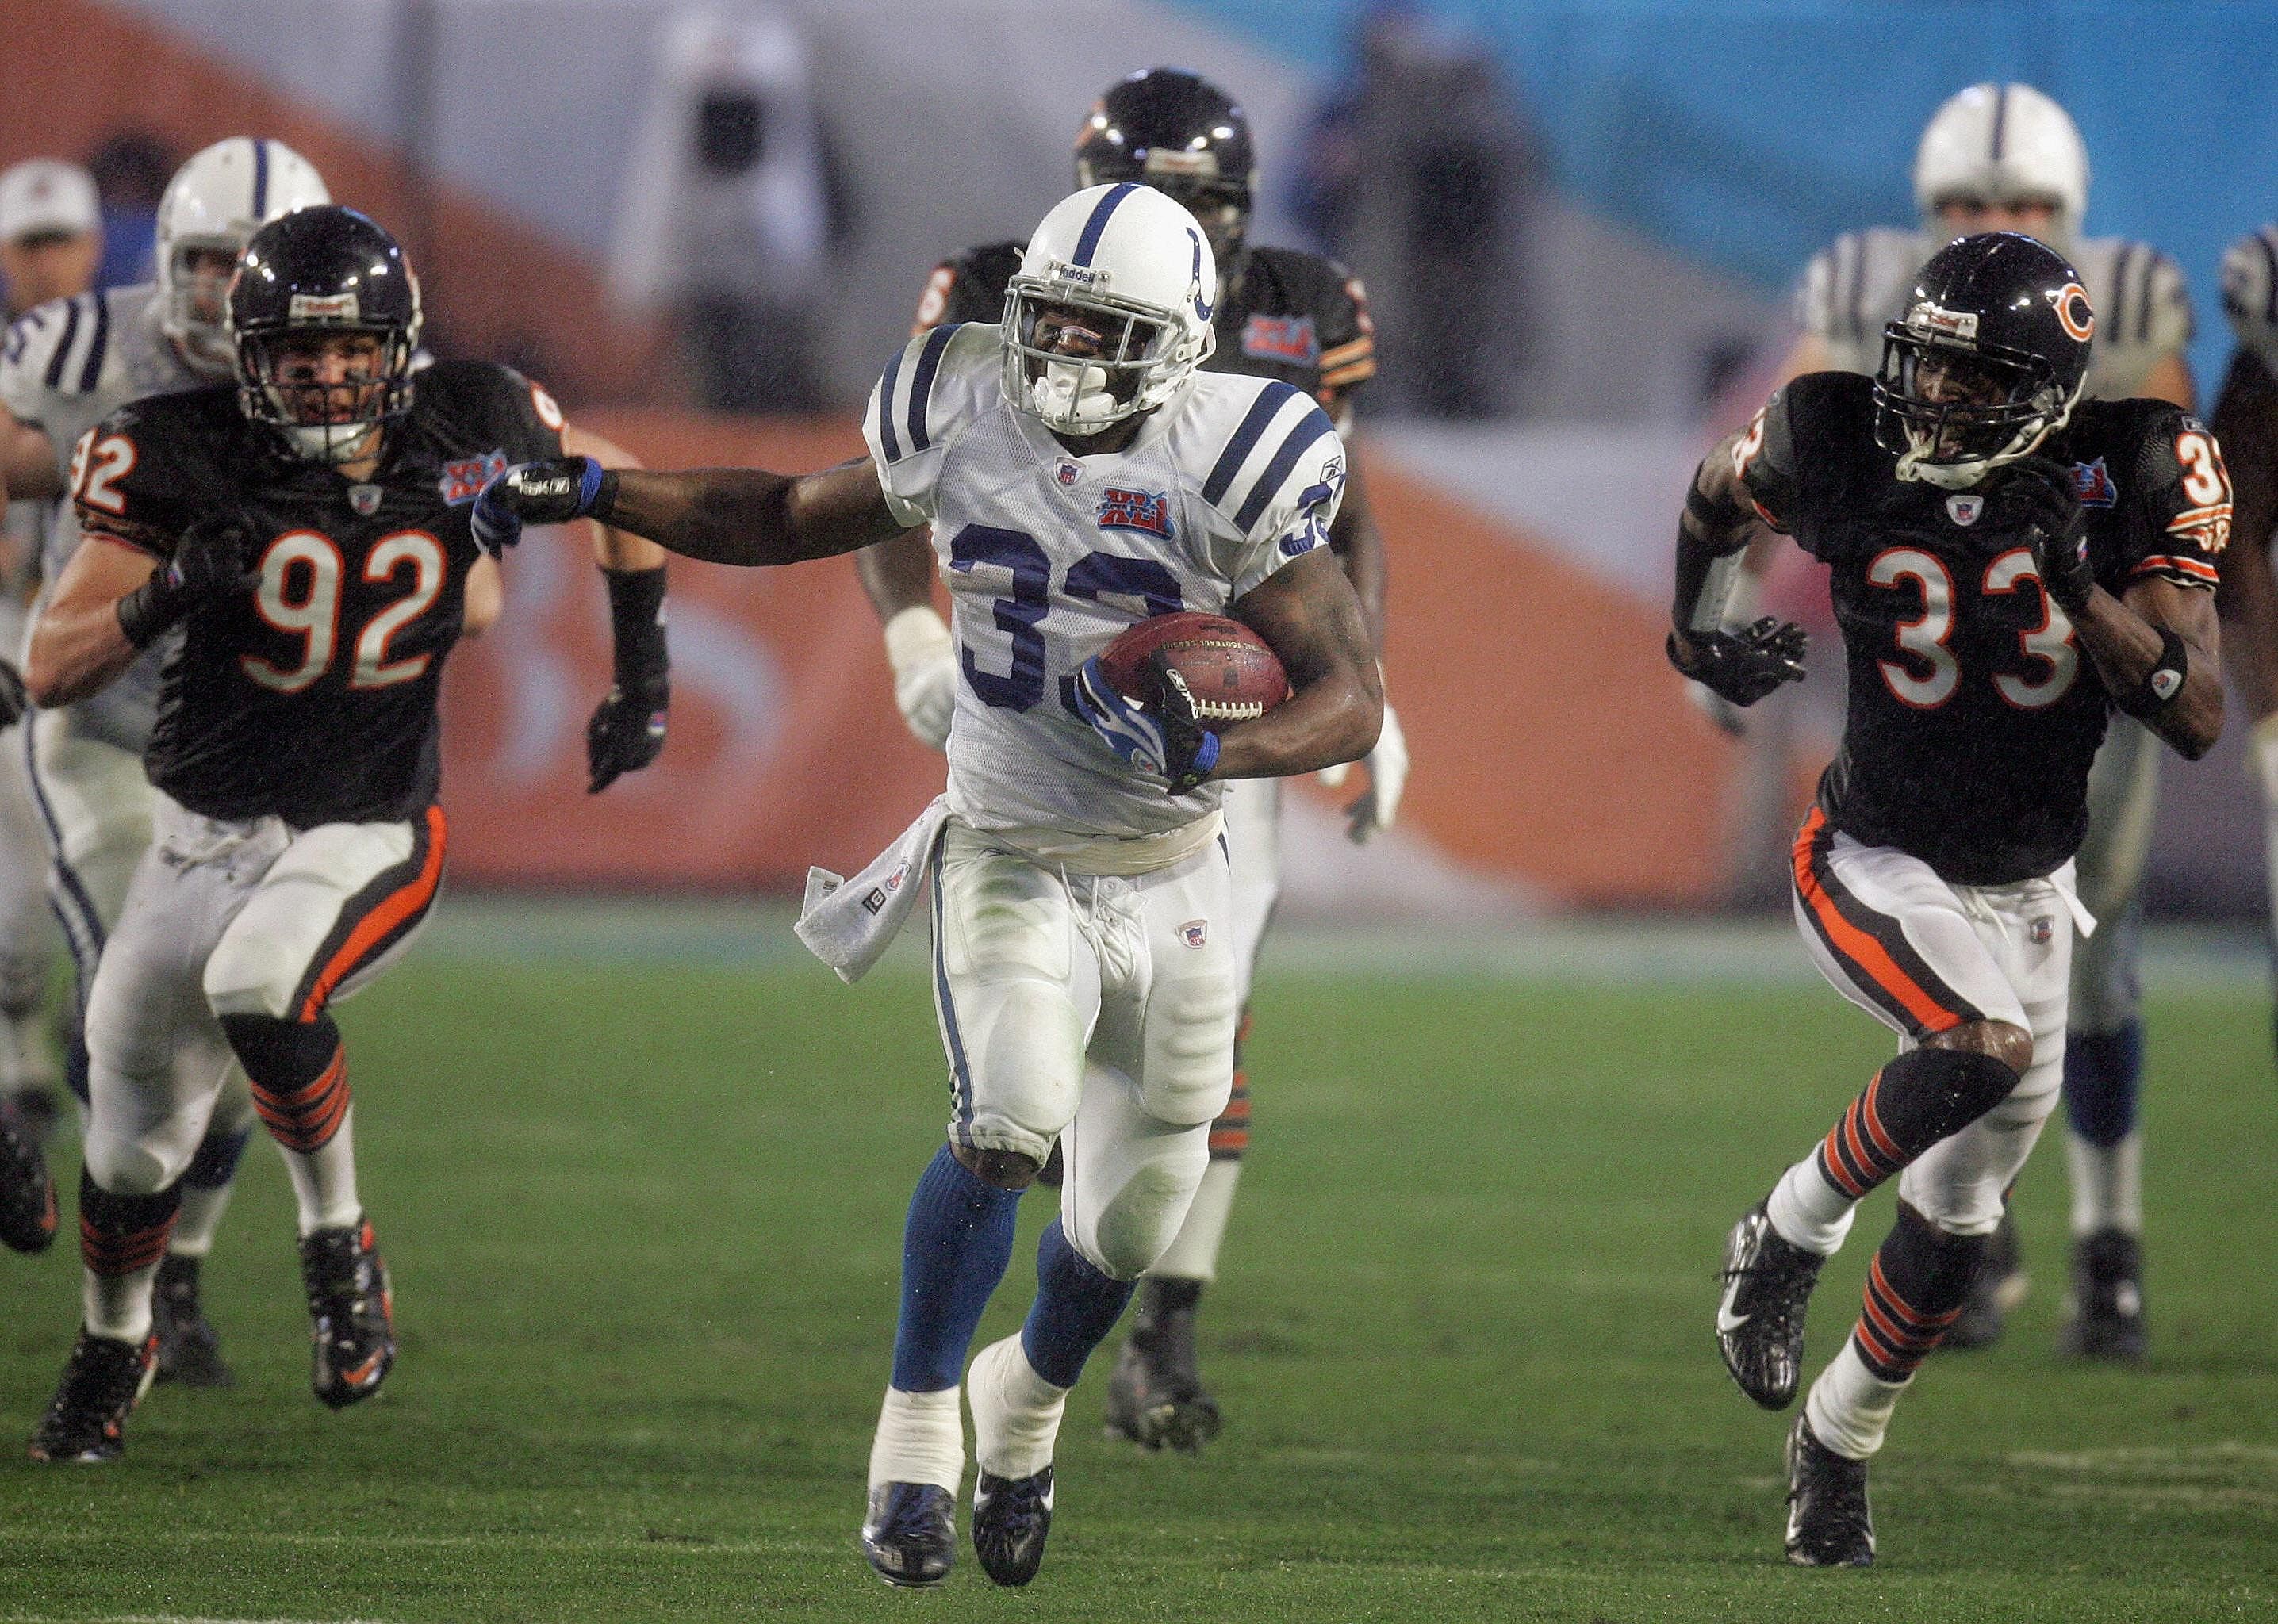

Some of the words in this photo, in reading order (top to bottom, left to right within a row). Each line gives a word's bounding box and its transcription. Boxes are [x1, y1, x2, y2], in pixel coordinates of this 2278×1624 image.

[2175, 431, 2234, 504] 3
[239, 528, 448, 695] 92
[1866, 545, 2082, 711] 33
